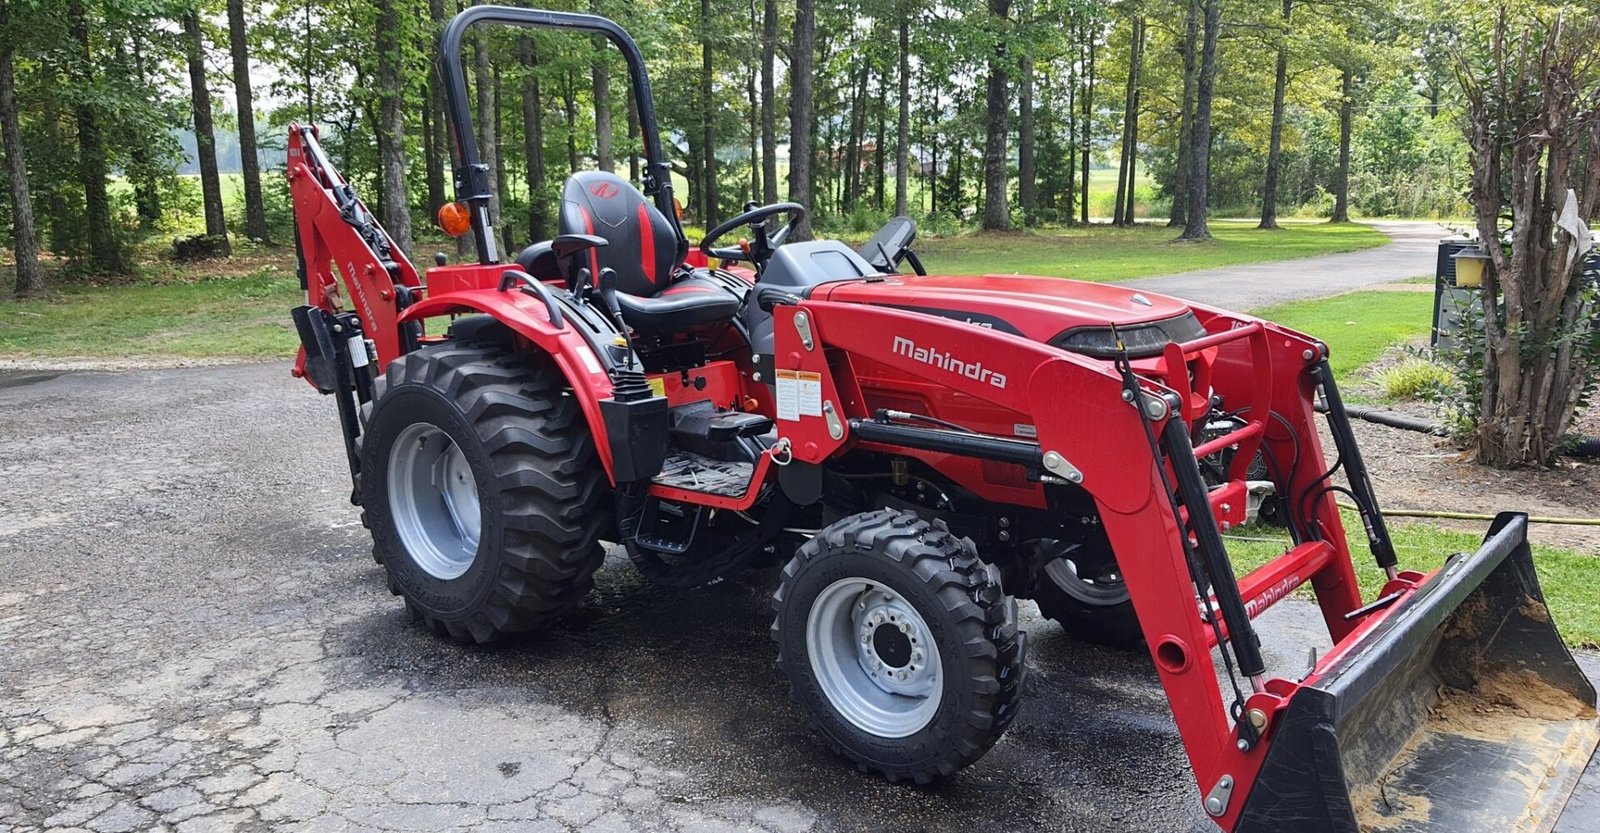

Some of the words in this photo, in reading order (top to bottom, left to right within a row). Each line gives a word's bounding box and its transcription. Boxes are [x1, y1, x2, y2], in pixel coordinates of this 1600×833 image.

[347, 261, 378, 332] Mahindra
[892, 335, 1007, 389] Mahindra
[1244, 576, 1300, 619] Mahindra
